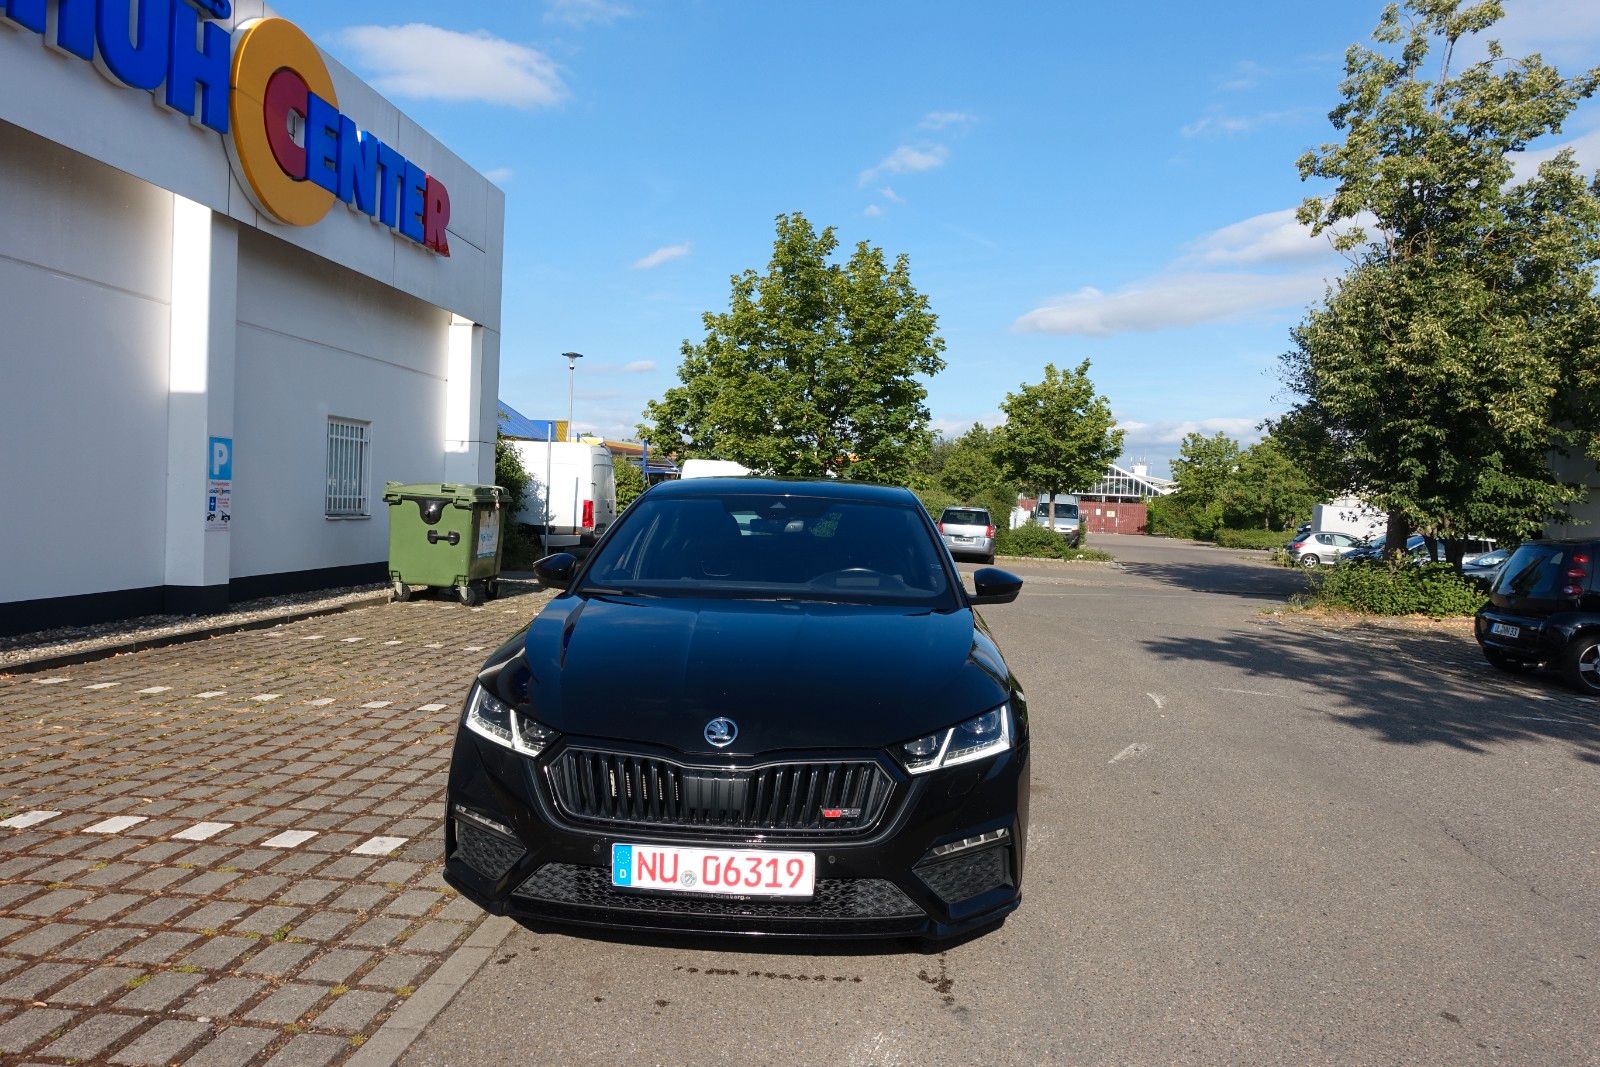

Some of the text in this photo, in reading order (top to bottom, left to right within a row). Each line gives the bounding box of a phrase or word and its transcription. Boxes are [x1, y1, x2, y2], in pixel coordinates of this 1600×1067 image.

[264, 68, 450, 257] CENTER
[213, 443, 228, 475] P
[637, 851, 679, 884] NU
[702, 855, 805, 889] 06319
